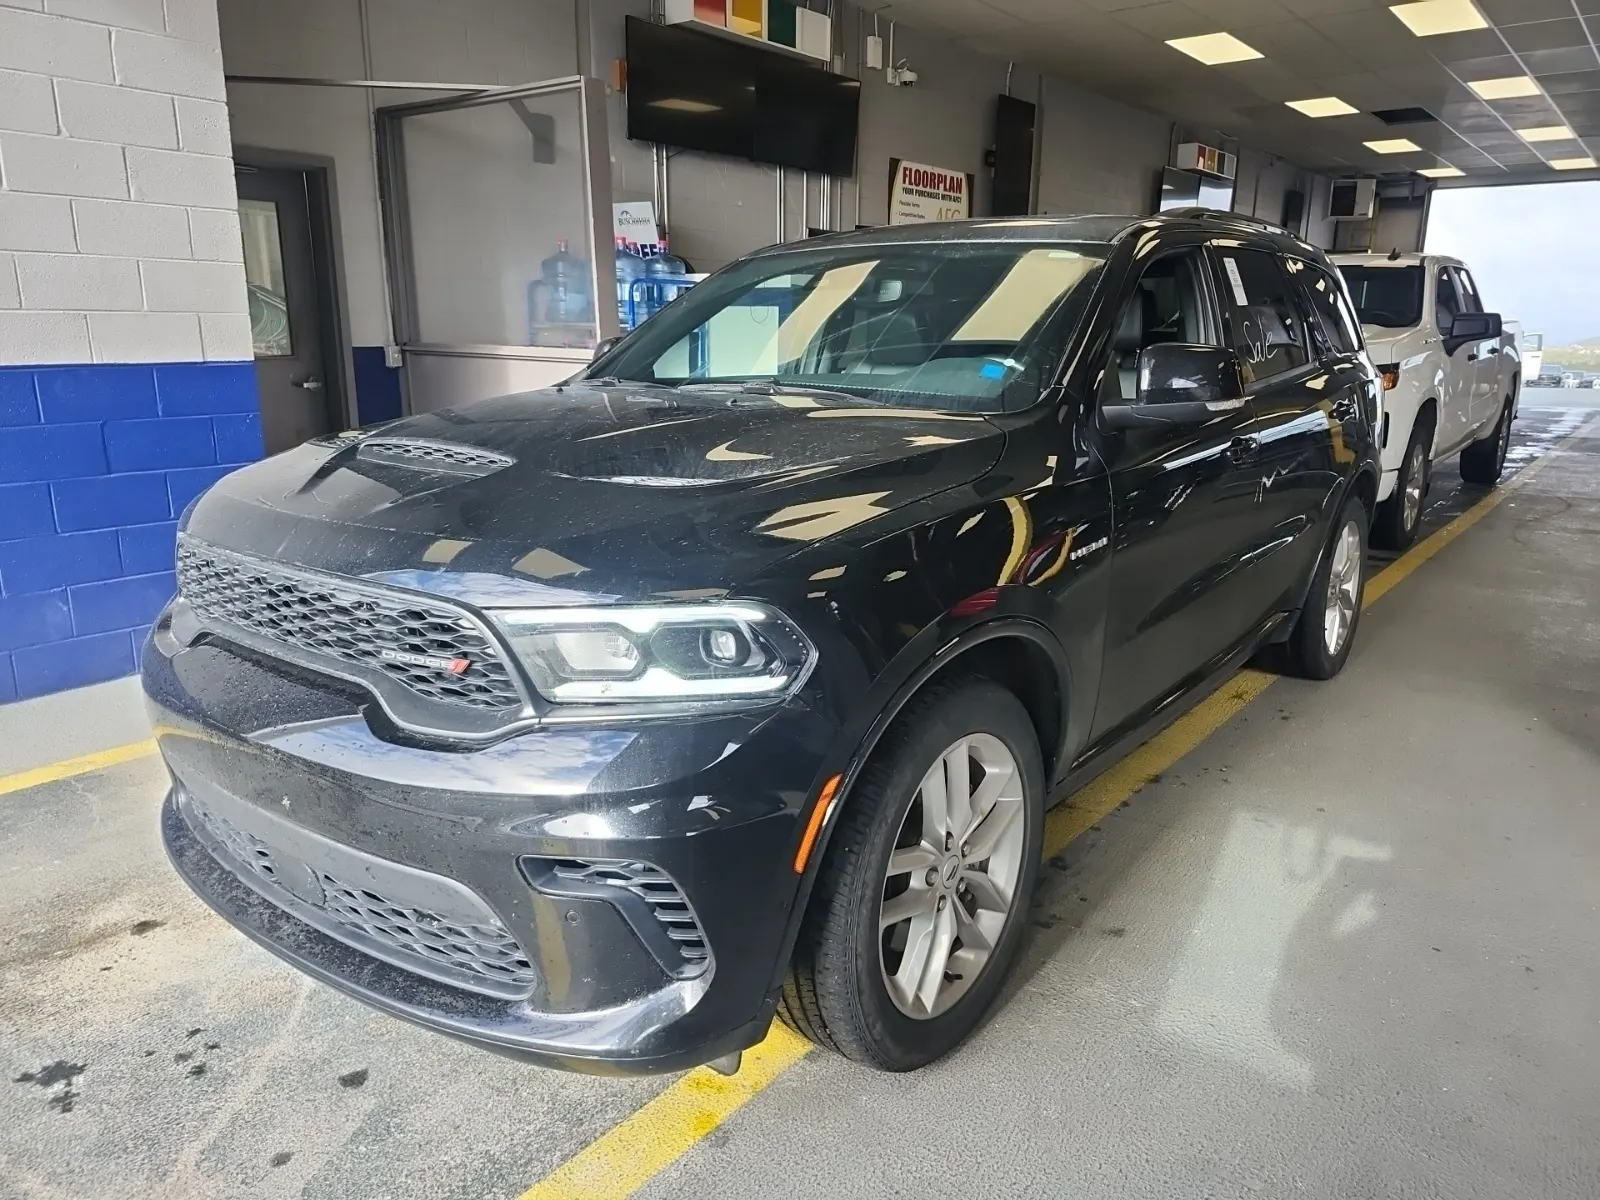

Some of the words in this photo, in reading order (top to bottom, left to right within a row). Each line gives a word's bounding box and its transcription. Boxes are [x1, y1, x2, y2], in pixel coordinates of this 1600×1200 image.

[902, 167, 963, 194] FLOORPLAN
[902, 187, 914, 196] YOUR
[915, 189, 940, 201] PURCHASES
[941, 193, 953, 202] WITH
[1243, 314, 1278, 363] Sale
[1069, 536, 1108, 560] HEMI
[382, 650, 451, 669] DODGE
